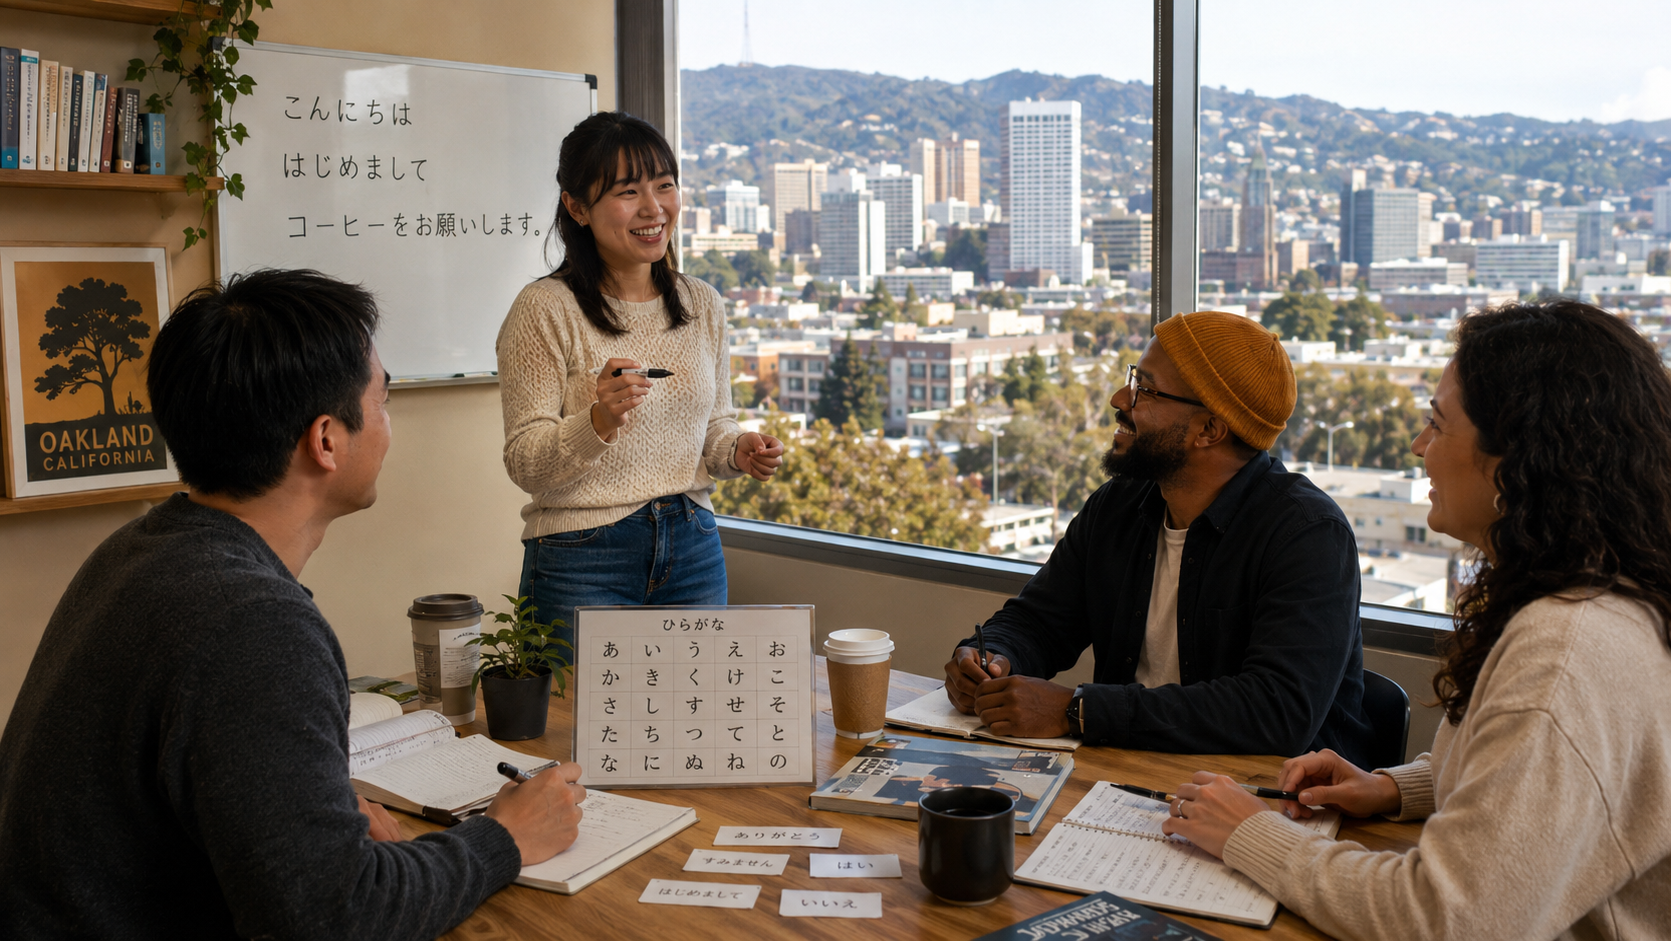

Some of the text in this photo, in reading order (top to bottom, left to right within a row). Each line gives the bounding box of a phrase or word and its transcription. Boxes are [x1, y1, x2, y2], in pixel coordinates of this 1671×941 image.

[284, 95, 413, 126] こんにちは
[283, 152, 428, 182] はじめまして
[288, 212, 541, 238] コーヒーをお願いします。
[39, 424, 154, 454] OAKLAND
[43, 448, 155, 472] CALIFORNIA
[662, 617, 725, 632] ひらがな
[603, 641, 786, 658] あ い う え お
[602, 668, 784, 686] か き く け こ
[603, 696, 786, 714] さ し す せ そ
[601, 724, 784, 743] た ち つ て と
[601, 753, 787, 772] な に ぬ ね の
[734, 831, 821, 841] ありがとう
[703, 856, 774, 868] すみません
[837, 861, 875, 870] はい
[658, 888, 743, 899] はじめまして
[801, 899, 858, 909] いいえ
